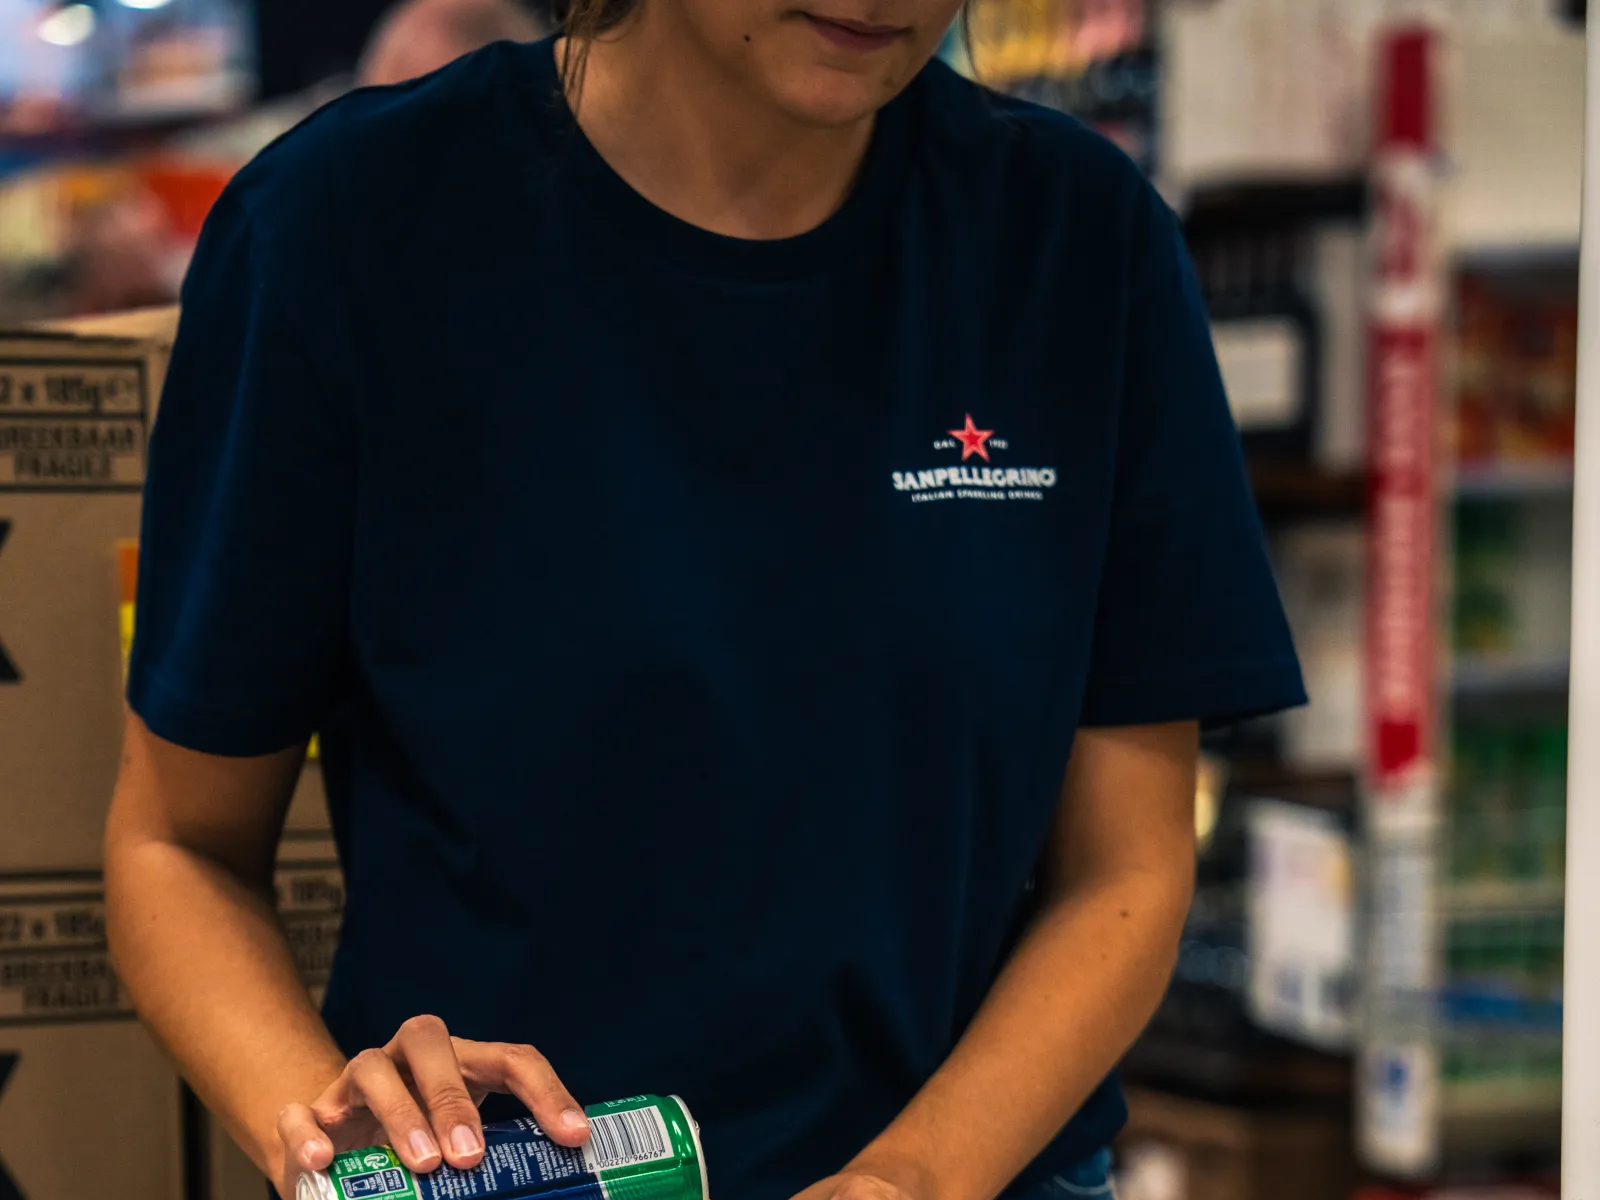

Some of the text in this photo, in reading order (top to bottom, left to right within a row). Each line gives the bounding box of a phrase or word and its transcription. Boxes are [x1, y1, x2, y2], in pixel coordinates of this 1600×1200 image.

[892, 466, 1057, 490] SANPELLEGRINO
[911, 489, 1043, 502] ITALIAN SPARKLING DRINKS
[599, 1157, 630, 1169] 002270
[633, 1150, 663, 1162] 966767
